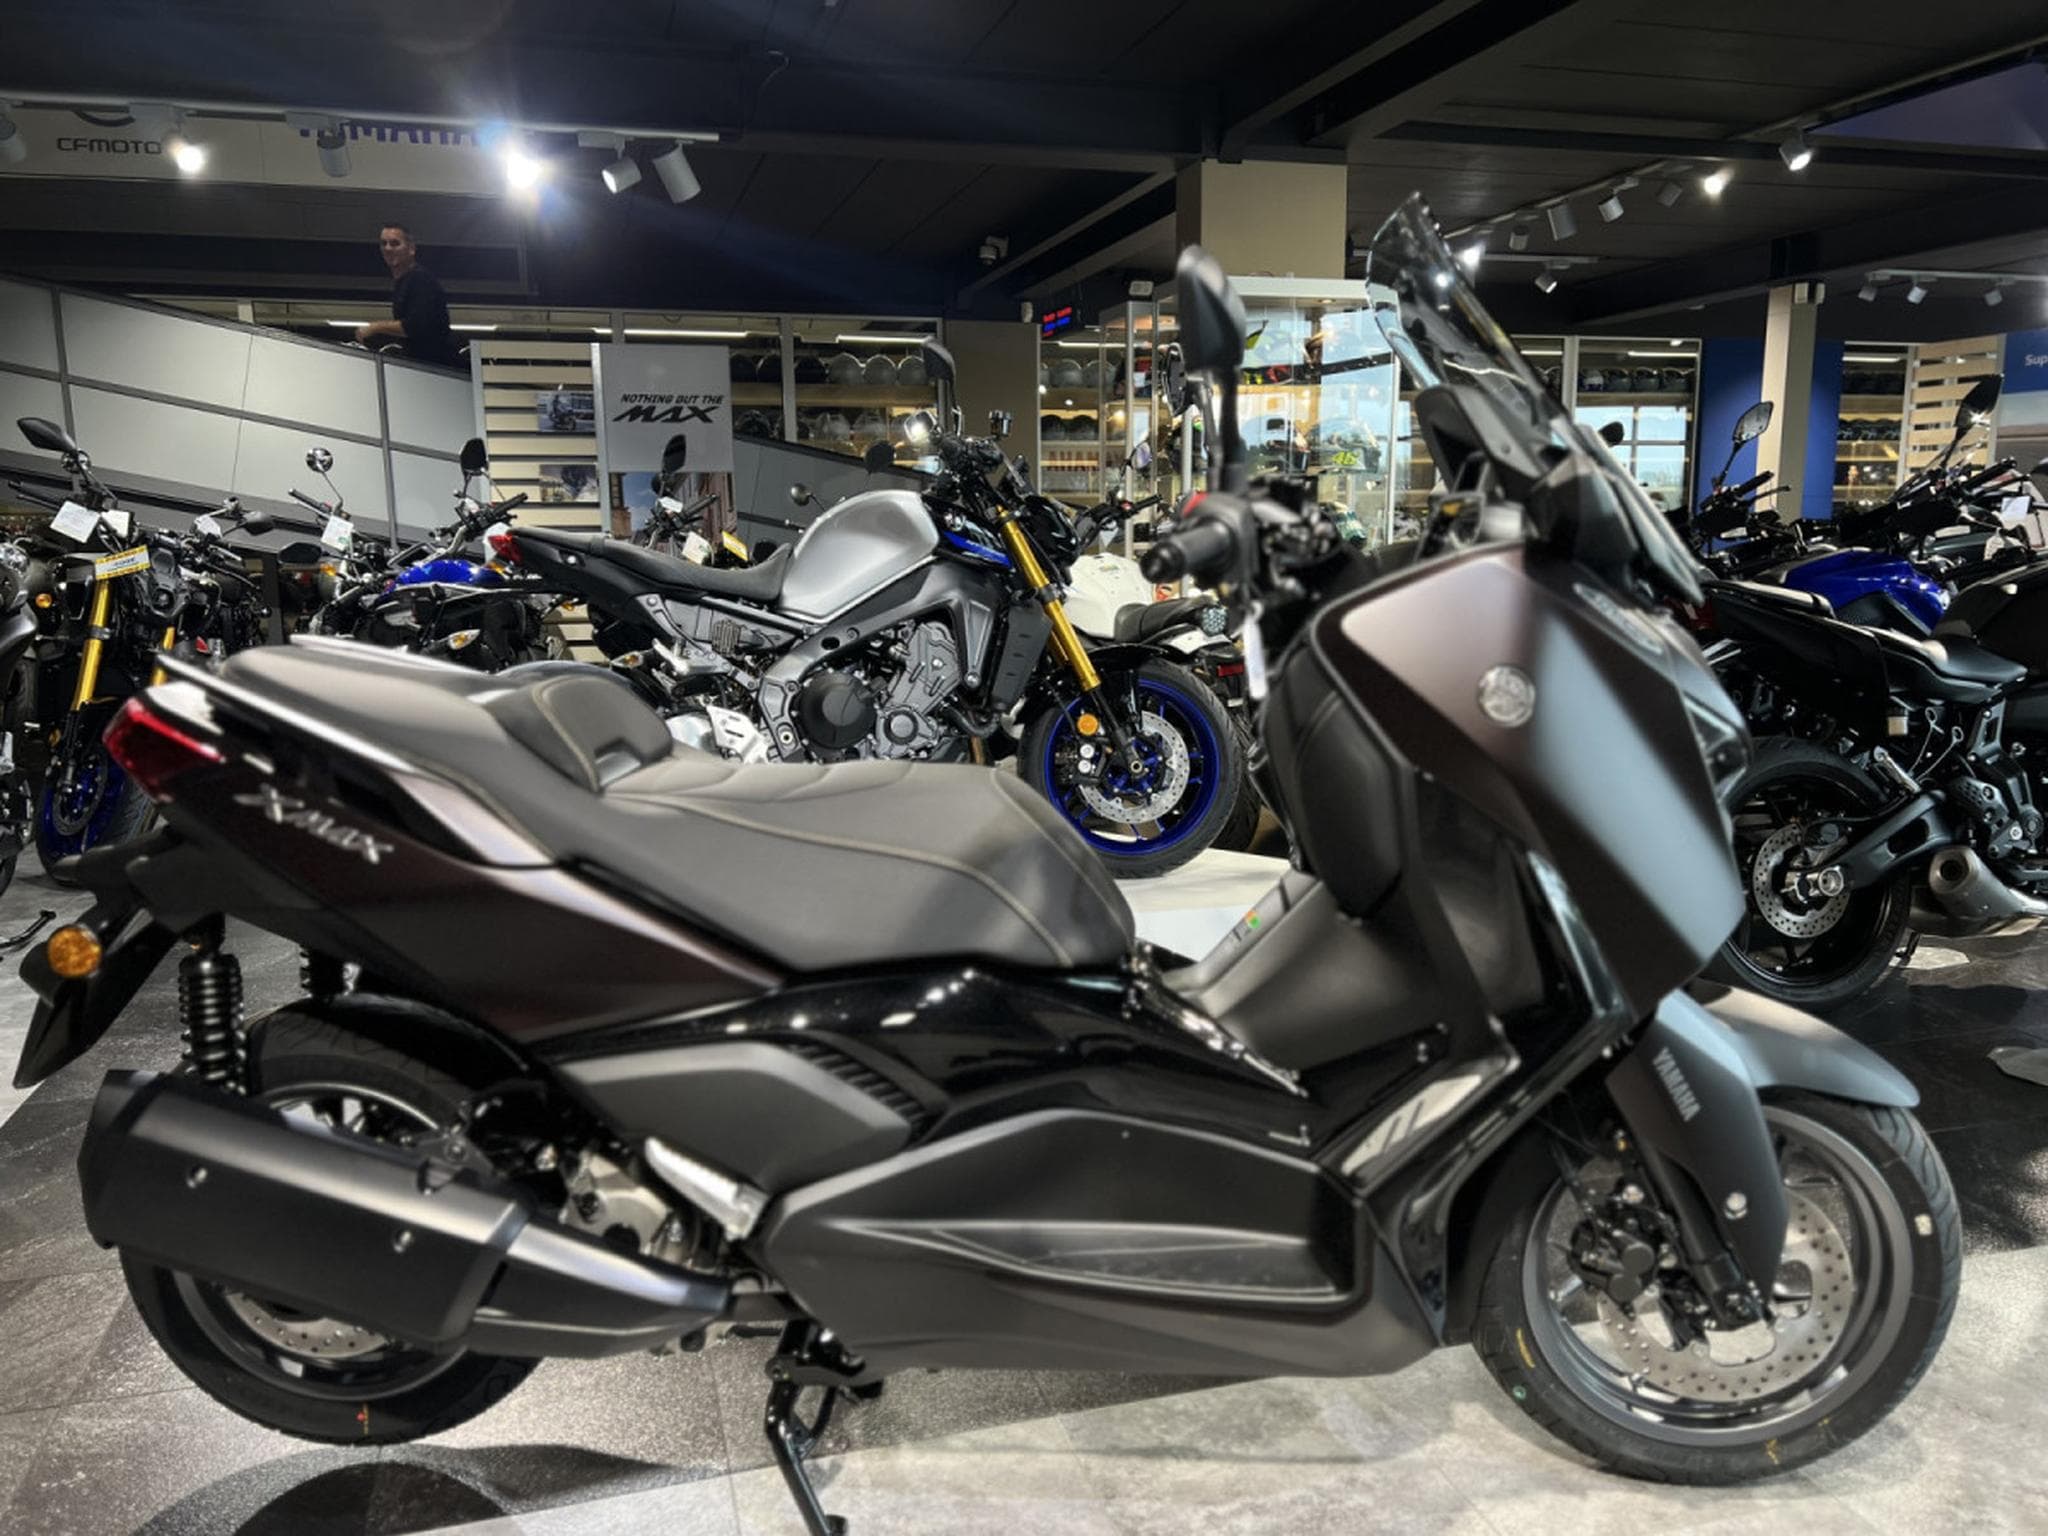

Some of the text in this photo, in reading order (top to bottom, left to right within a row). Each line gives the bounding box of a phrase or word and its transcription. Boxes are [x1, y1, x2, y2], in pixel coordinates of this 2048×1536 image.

[57, 137, 162, 154] CFMOTO
[621, 393, 724, 404] NOTHING BUT THE
[612, 405, 720, 423] MAX
[1653, 1047, 1701, 1122] YAMAHA
